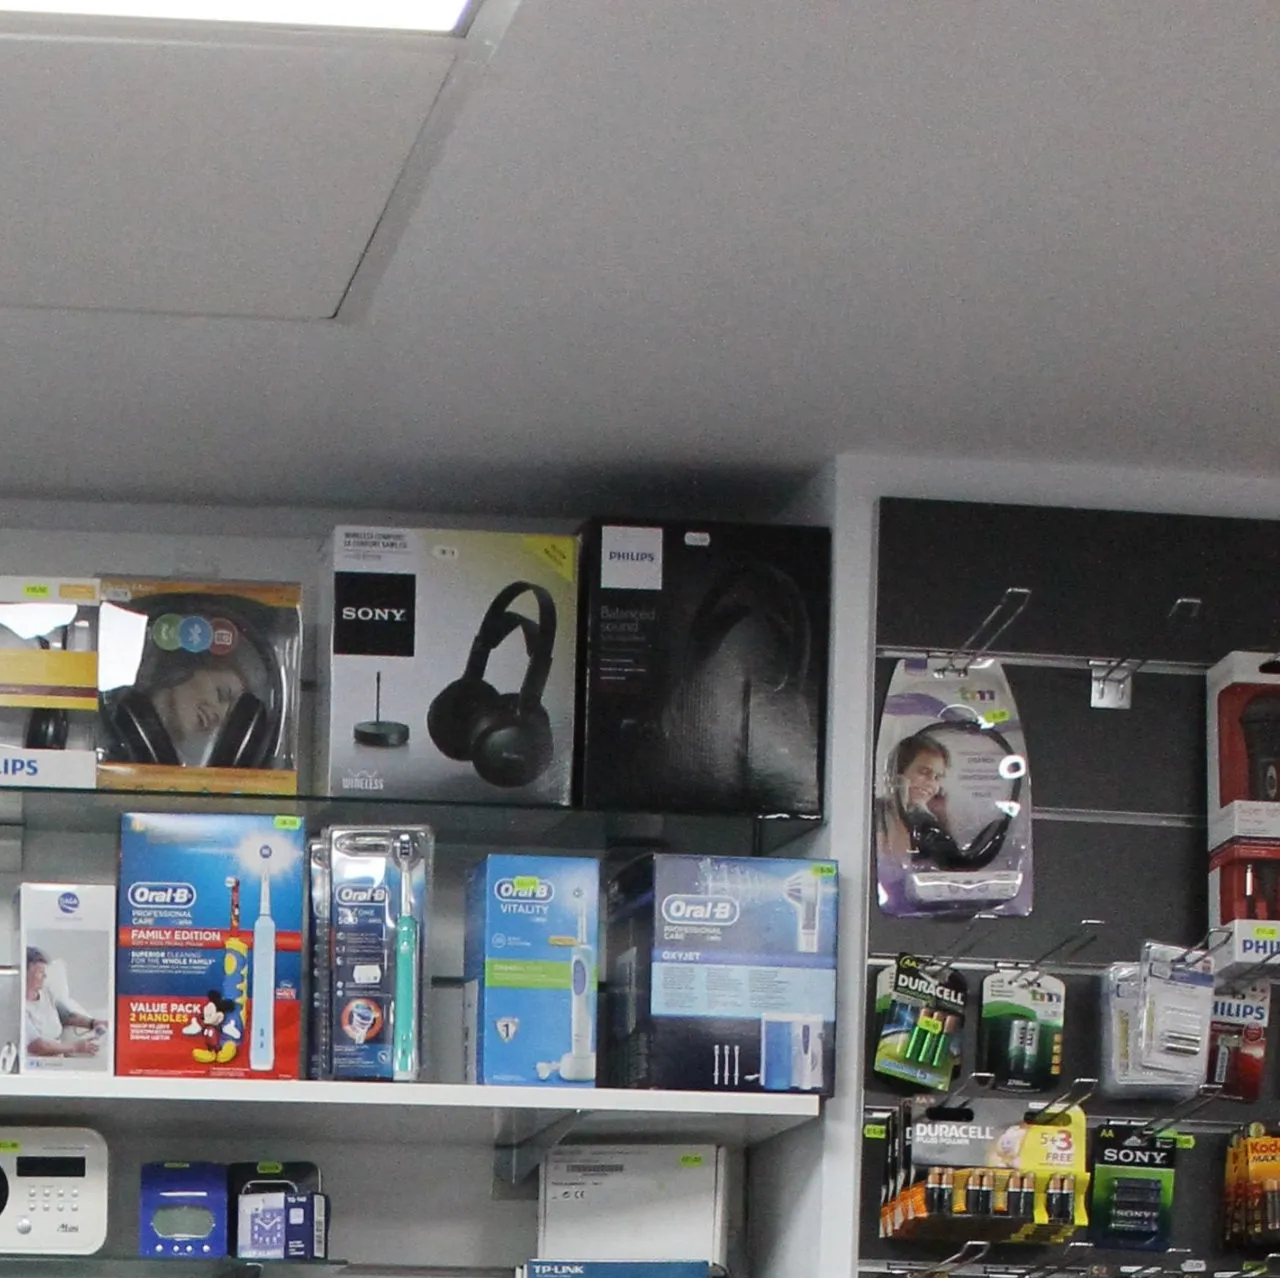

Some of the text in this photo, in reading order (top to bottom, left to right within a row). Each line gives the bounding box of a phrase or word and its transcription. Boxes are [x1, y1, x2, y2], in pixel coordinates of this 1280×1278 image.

[609, 551, 655, 562] PHILIPS
[342, 607, 406, 622] SONY
[342, 777, 384, 791] WIRELESS
[131, 910, 192, 918] PROFESSIONAL
[500, 904, 549, 914] VITALITY
[131, 930, 221, 942] FAMILY EDITION
[662, 951, 701, 961] OXYJET
[897, 973, 965, 1006] DURACELL
[130, 1003, 201, 1013] VALUE PACK
[130, 1013, 189, 1023] 2 HANDLES
[502, 1024, 510, 1036] 1
[916, 1123, 994, 1140] DURACELL
[1100, 1129, 1115, 1139] AA
[1045, 1152, 1075, 1162] FREE
[1103, 1149, 1168, 1164] SONY
[533, 1265, 584, 1274] TP-LINK
